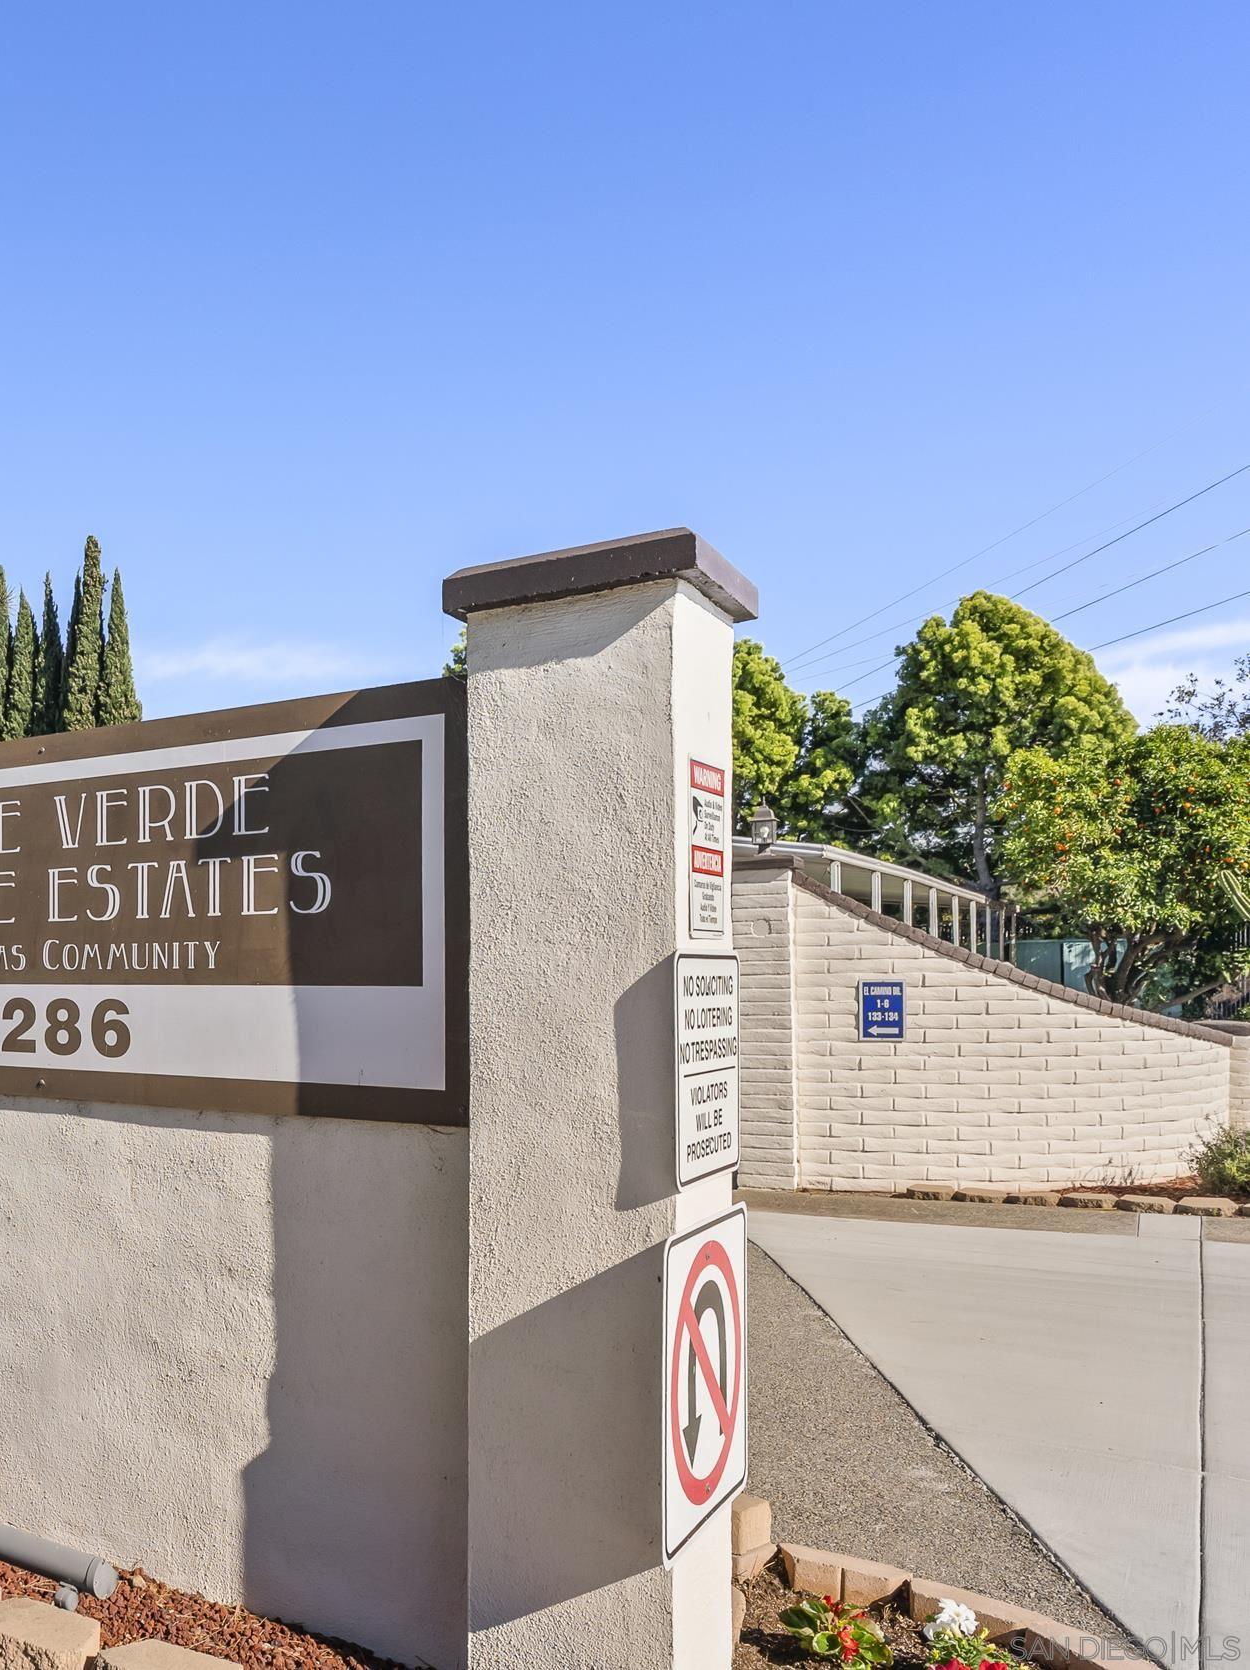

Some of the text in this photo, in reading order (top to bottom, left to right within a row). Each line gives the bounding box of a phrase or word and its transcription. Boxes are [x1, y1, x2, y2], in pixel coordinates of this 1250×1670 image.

[694, 765, 722, 791] WARNING
[53, 773, 270, 848] VERDE
[47, 850, 332, 922] ESTATES
[683, 976, 733, 997] NO SOLICITING
[864, 986, 869, 995] EL
[870, 986, 892, 995] CAMINO
[684, 1006, 732, 1030] NO LOITERING
[868, 1011, 899, 1021] 133-134
[680, 1036, 737, 1064] NO TRESPASSING
[691, 1081, 728, 1106] VIOLATORS
[696, 1108, 723, 1132] WILL BE
[687, 1131, 732, 1163] PROSECUTED
